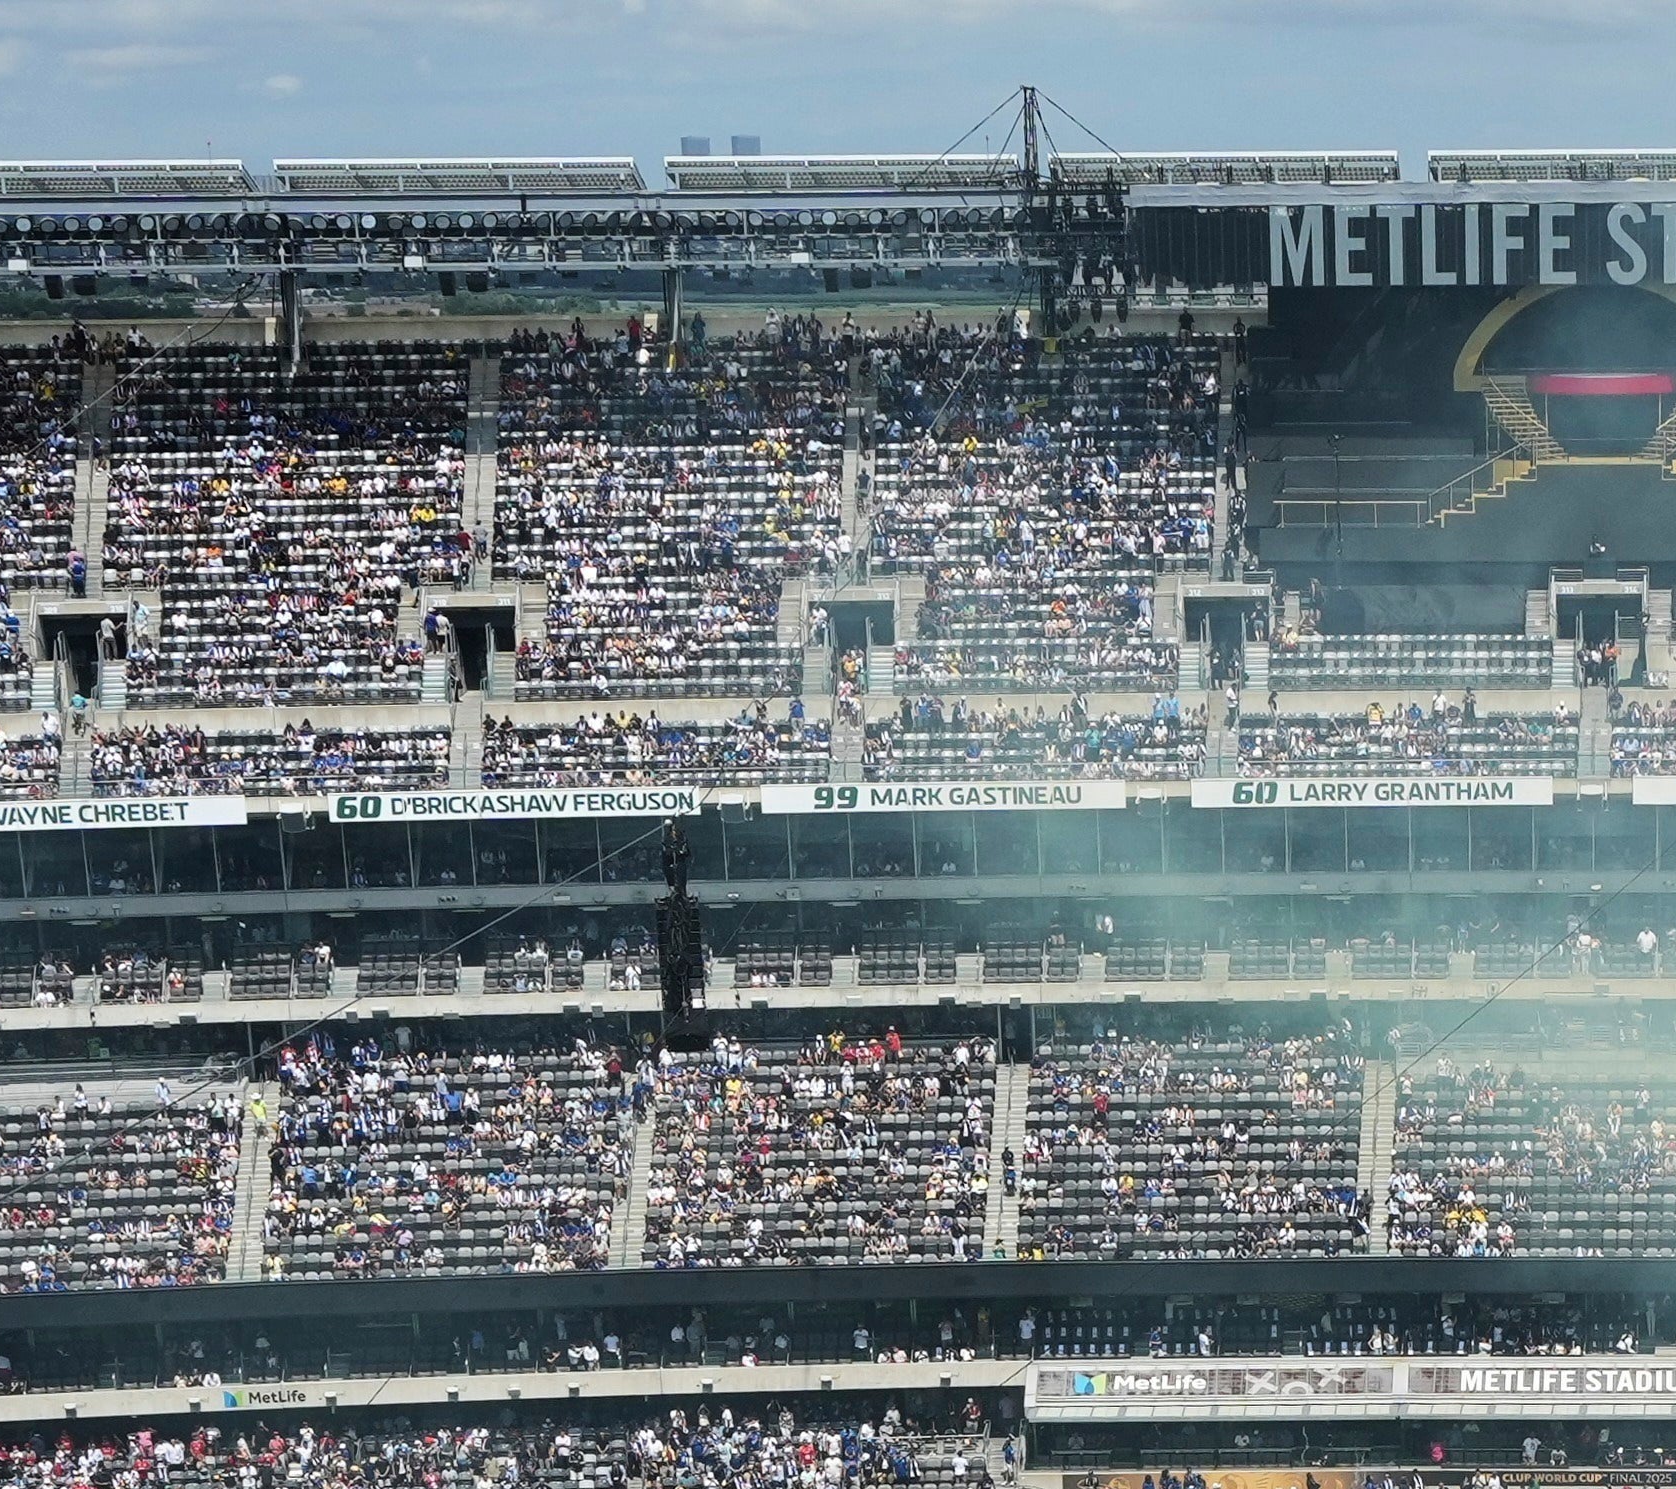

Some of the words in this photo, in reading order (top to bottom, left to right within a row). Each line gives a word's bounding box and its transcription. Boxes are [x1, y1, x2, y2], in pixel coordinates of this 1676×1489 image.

[1270, 203, 1578, 286] METLIFE
[813, 786, 859, 810] 99
[870, 785, 944, 806] MARK
[949, 784, 1083, 806] GASTINEAU
[1232, 781, 1278, 804] 60
[1289, 782, 1368, 802] LARRY
[1374, 780, 1514, 801] GRANTHAM
[78, 801, 191, 825] CHREBET
[336, 796, 383, 819] 60
[391, 793, 571, 816] D'BRICKASHAW
[574, 790, 695, 813] FERGUSON
[1112, 1373, 1208, 1391] MetLife
[1460, 1370, 1577, 1393] METLIFE
[248, 1389, 307, 1405] MetLife
[1534, 1473, 1576, 1484] WORLD
[1610, 1473, 1643, 1484] FINAL
[1646, 1473, 1673, 1484] 2025
